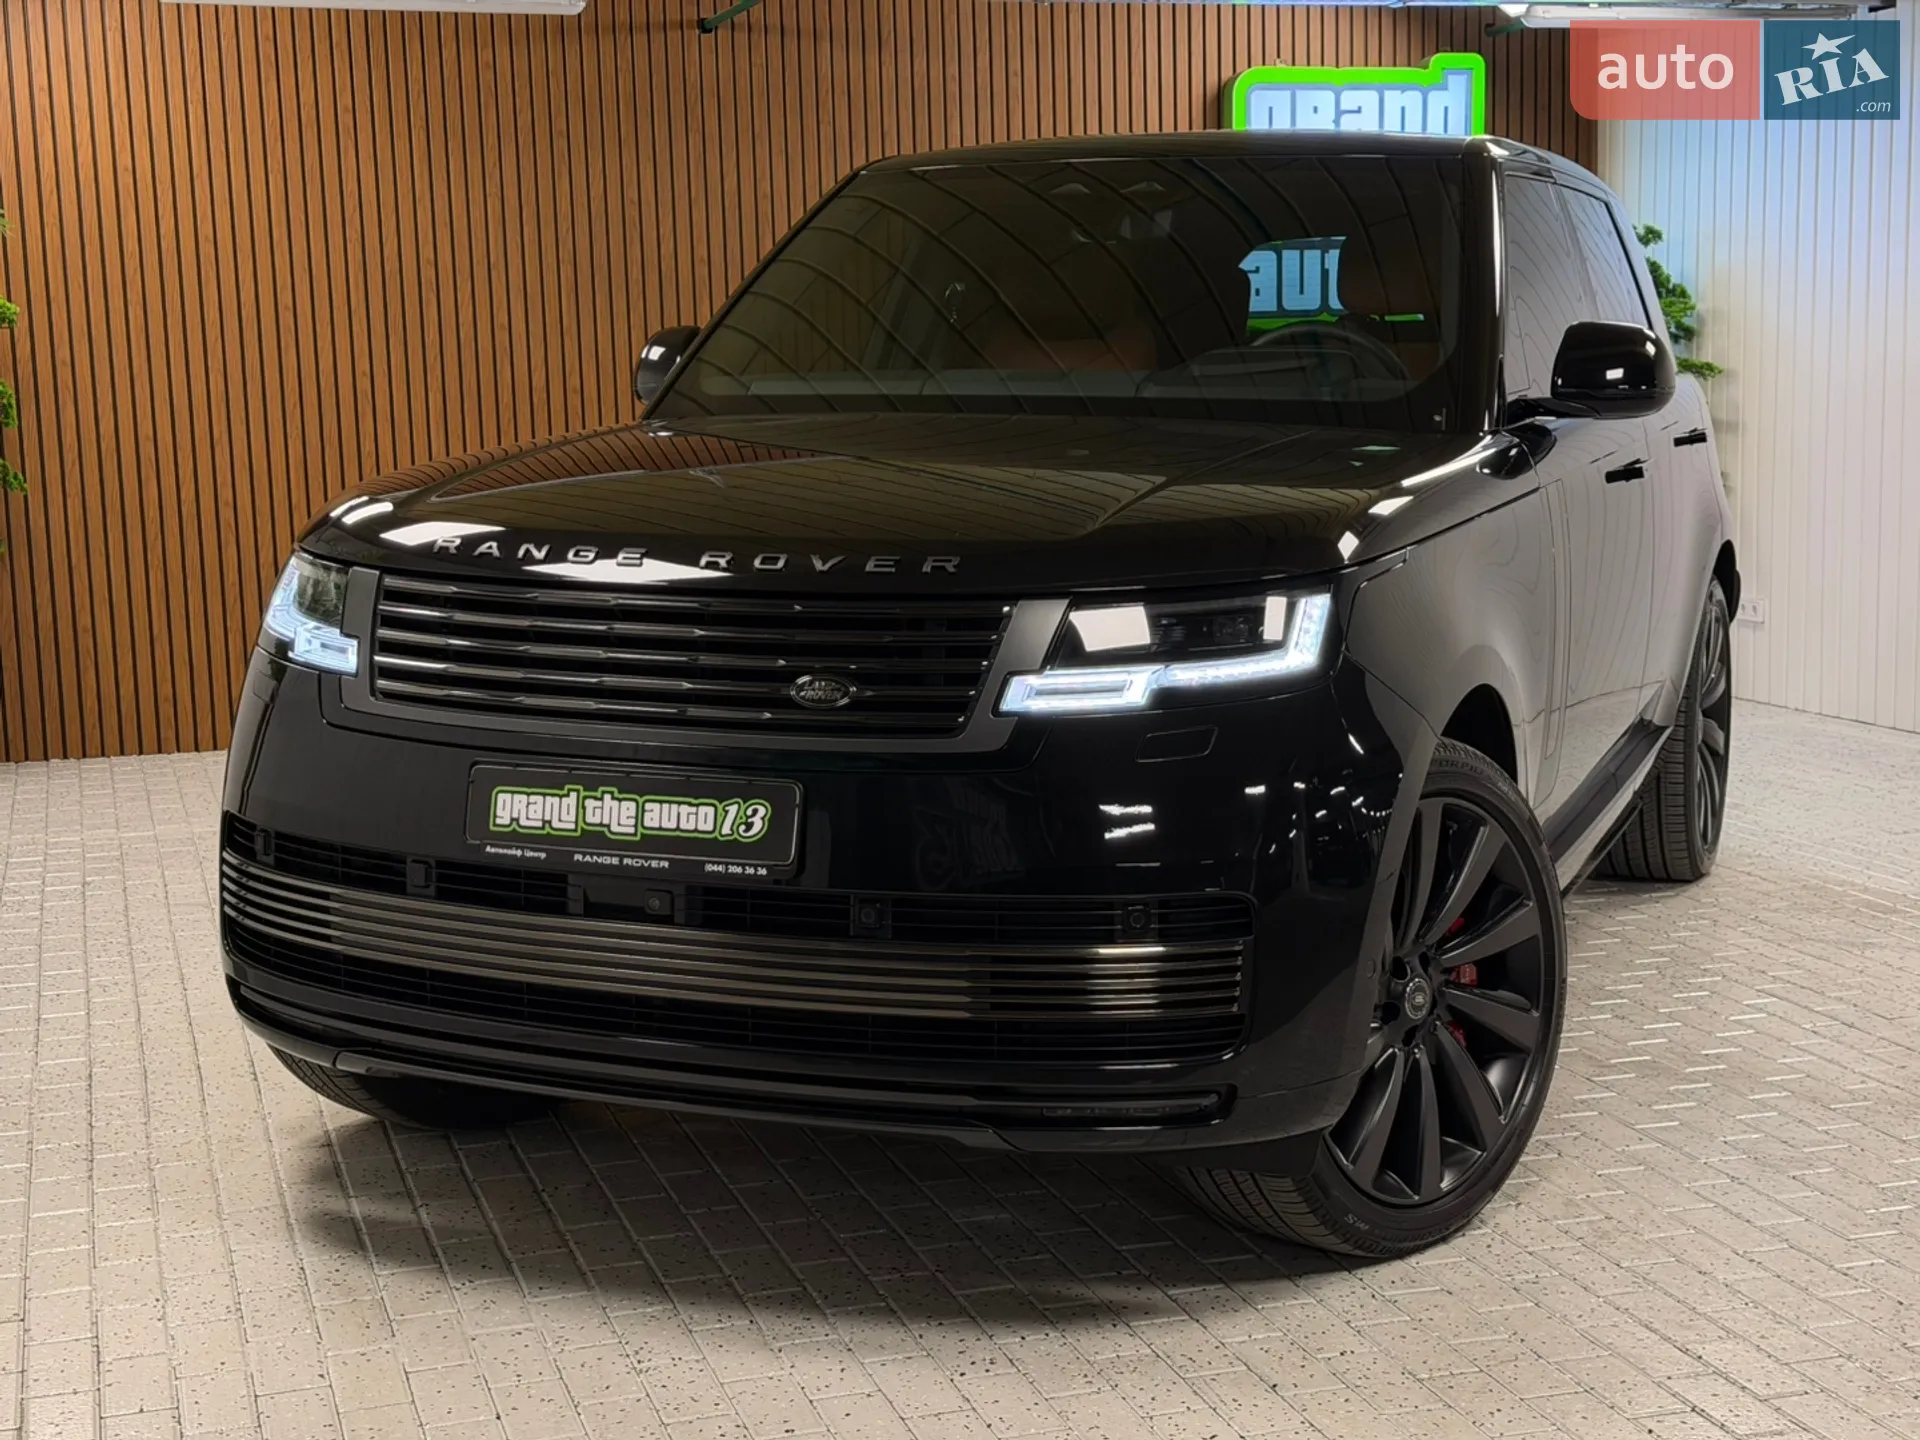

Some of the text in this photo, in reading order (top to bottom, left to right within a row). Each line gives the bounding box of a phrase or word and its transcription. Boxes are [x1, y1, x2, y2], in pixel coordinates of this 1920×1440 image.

[1239, 249, 1346, 312] aut
[433, 536, 961, 573] RANGE ROVER
[584, 793, 636, 835] the
[643, 801, 716, 832] auto
[721, 803, 767, 836] 13
[574, 853, 670, 869] RANGE ROVER
[704, 862, 768, 876] (044) 206 36 36
